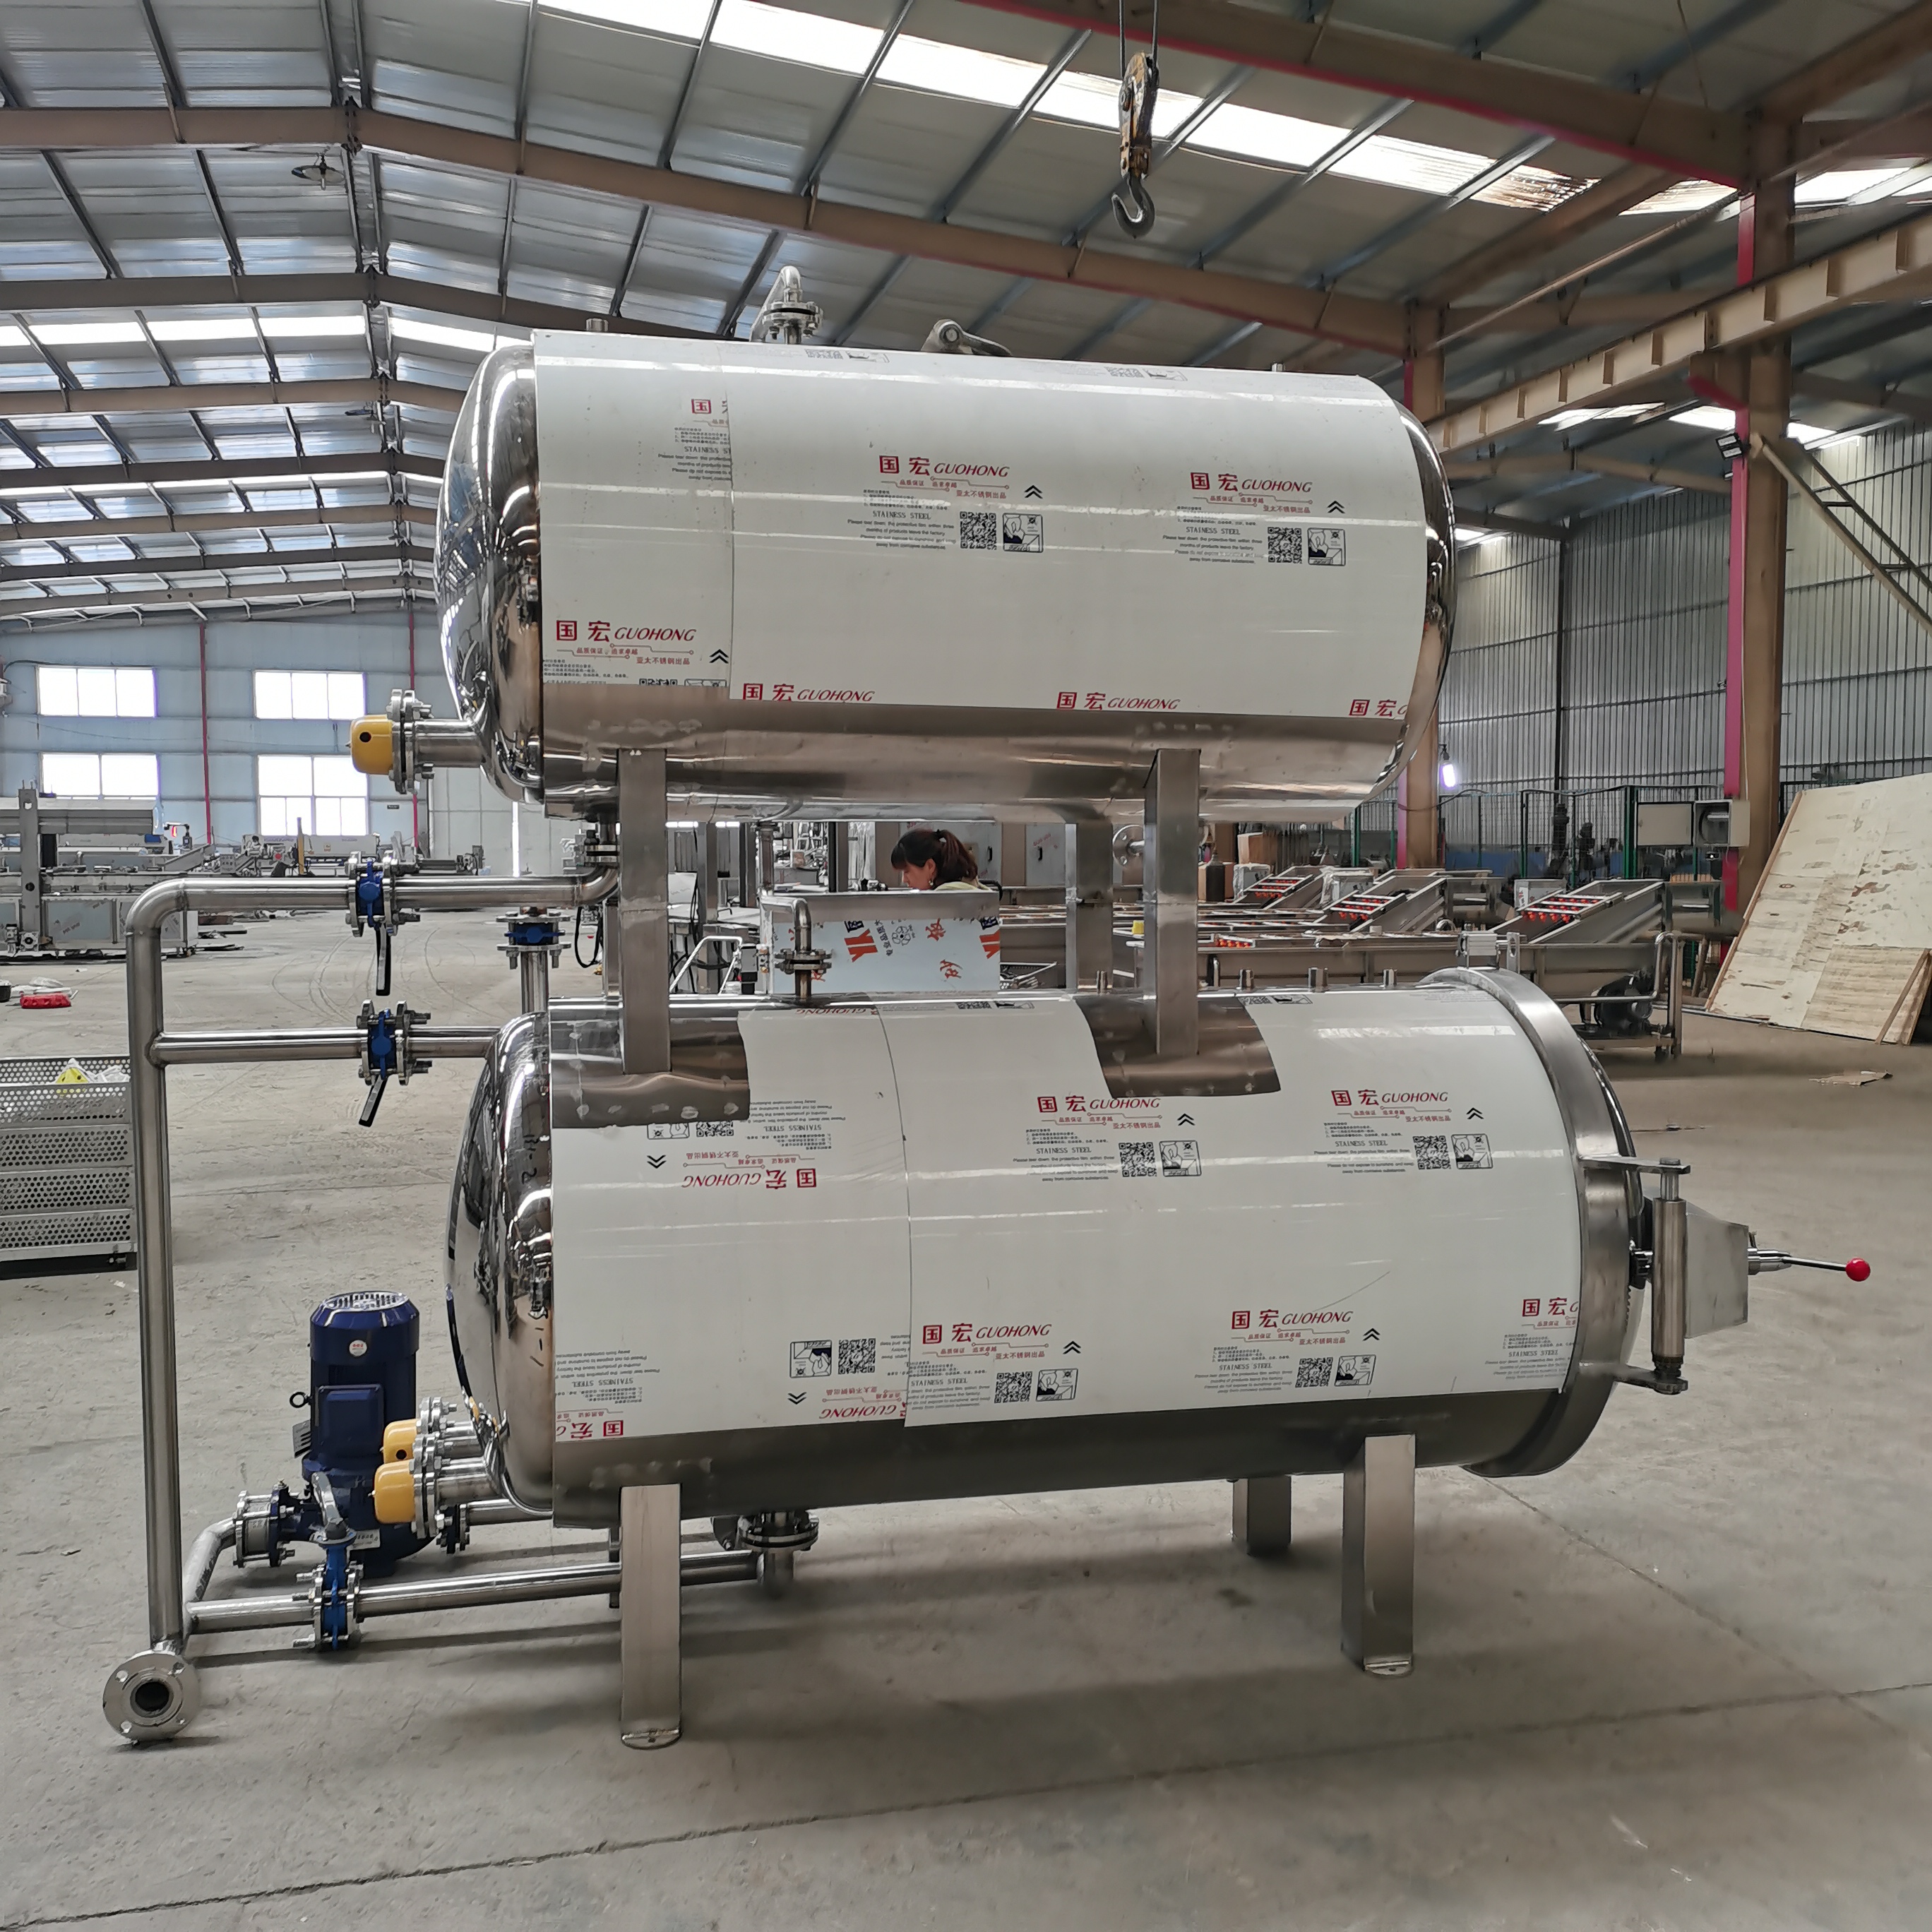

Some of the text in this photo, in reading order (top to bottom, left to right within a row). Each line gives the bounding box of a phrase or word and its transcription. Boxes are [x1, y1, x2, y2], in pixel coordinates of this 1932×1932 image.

[934, 463, 1010, 477] GUOHONG
[1241, 479, 1313, 493] GUOHONG
[614, 626, 697, 642] GUOHONG
[797, 688, 876, 702] GUOHONG
[1107, 697, 1181, 710] GUOHONG
[1089, 1097, 1161, 1110] GUOHONG
[1381, 1092, 1448, 1103] GUOHONG
[681, 1172, 762, 1188] GUOHONG
[1281, 1311, 1354, 1325] GUOHONG
[976, 1324, 1052, 1339] GUOHONG
[819, 1405, 897, 1419] GUOHONG
